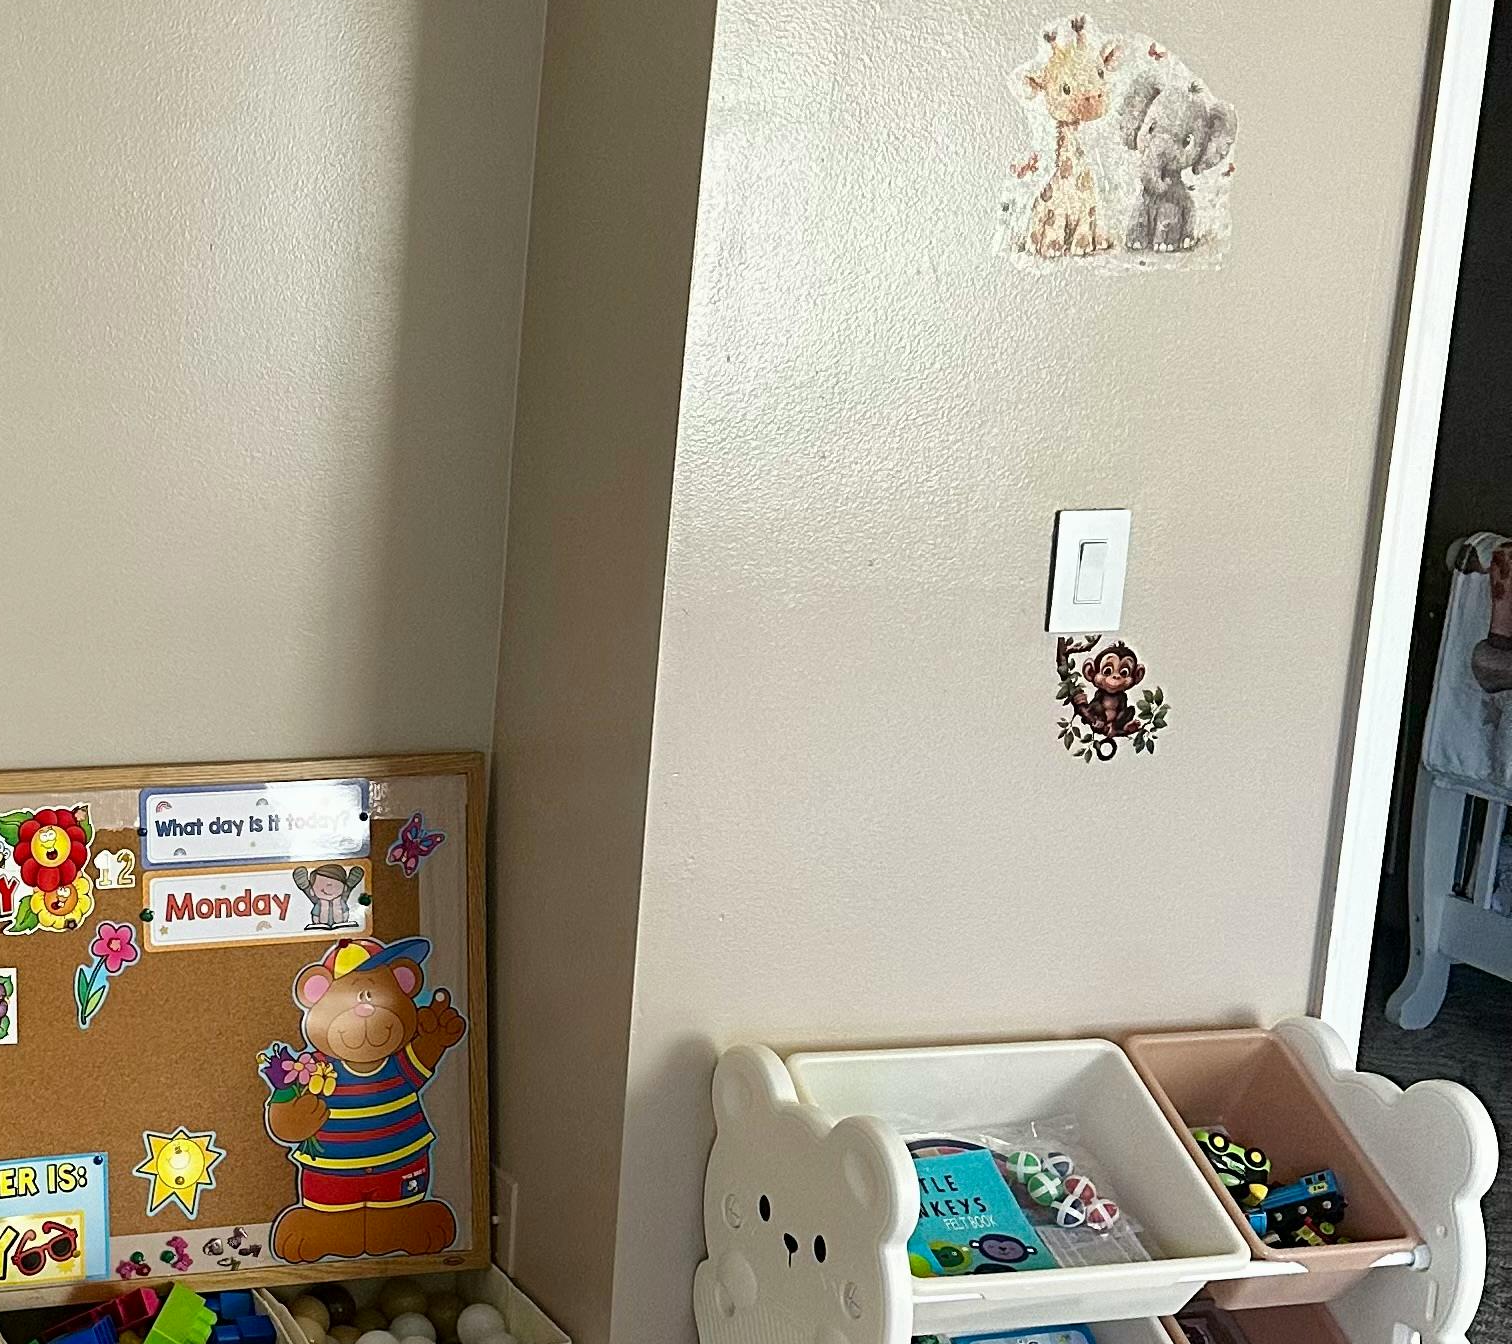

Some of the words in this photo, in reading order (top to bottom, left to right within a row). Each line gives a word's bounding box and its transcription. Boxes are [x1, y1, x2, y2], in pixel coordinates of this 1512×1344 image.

[155, 818, 203, 837] What
[209, 817, 244, 837] day
[249, 815, 263, 832] is
[269, 814, 280, 831] it
[286, 813, 350, 832] today?
[165, 889, 291, 923] Monday
[46, 1162, 88, 1194] IS:
[919, 1175, 958, 1195] TLE
[919, 1197, 987, 1218] NKEYS
[944, 1217, 968, 1231] FELT
[969, 1215, 999, 1229] BOOK
